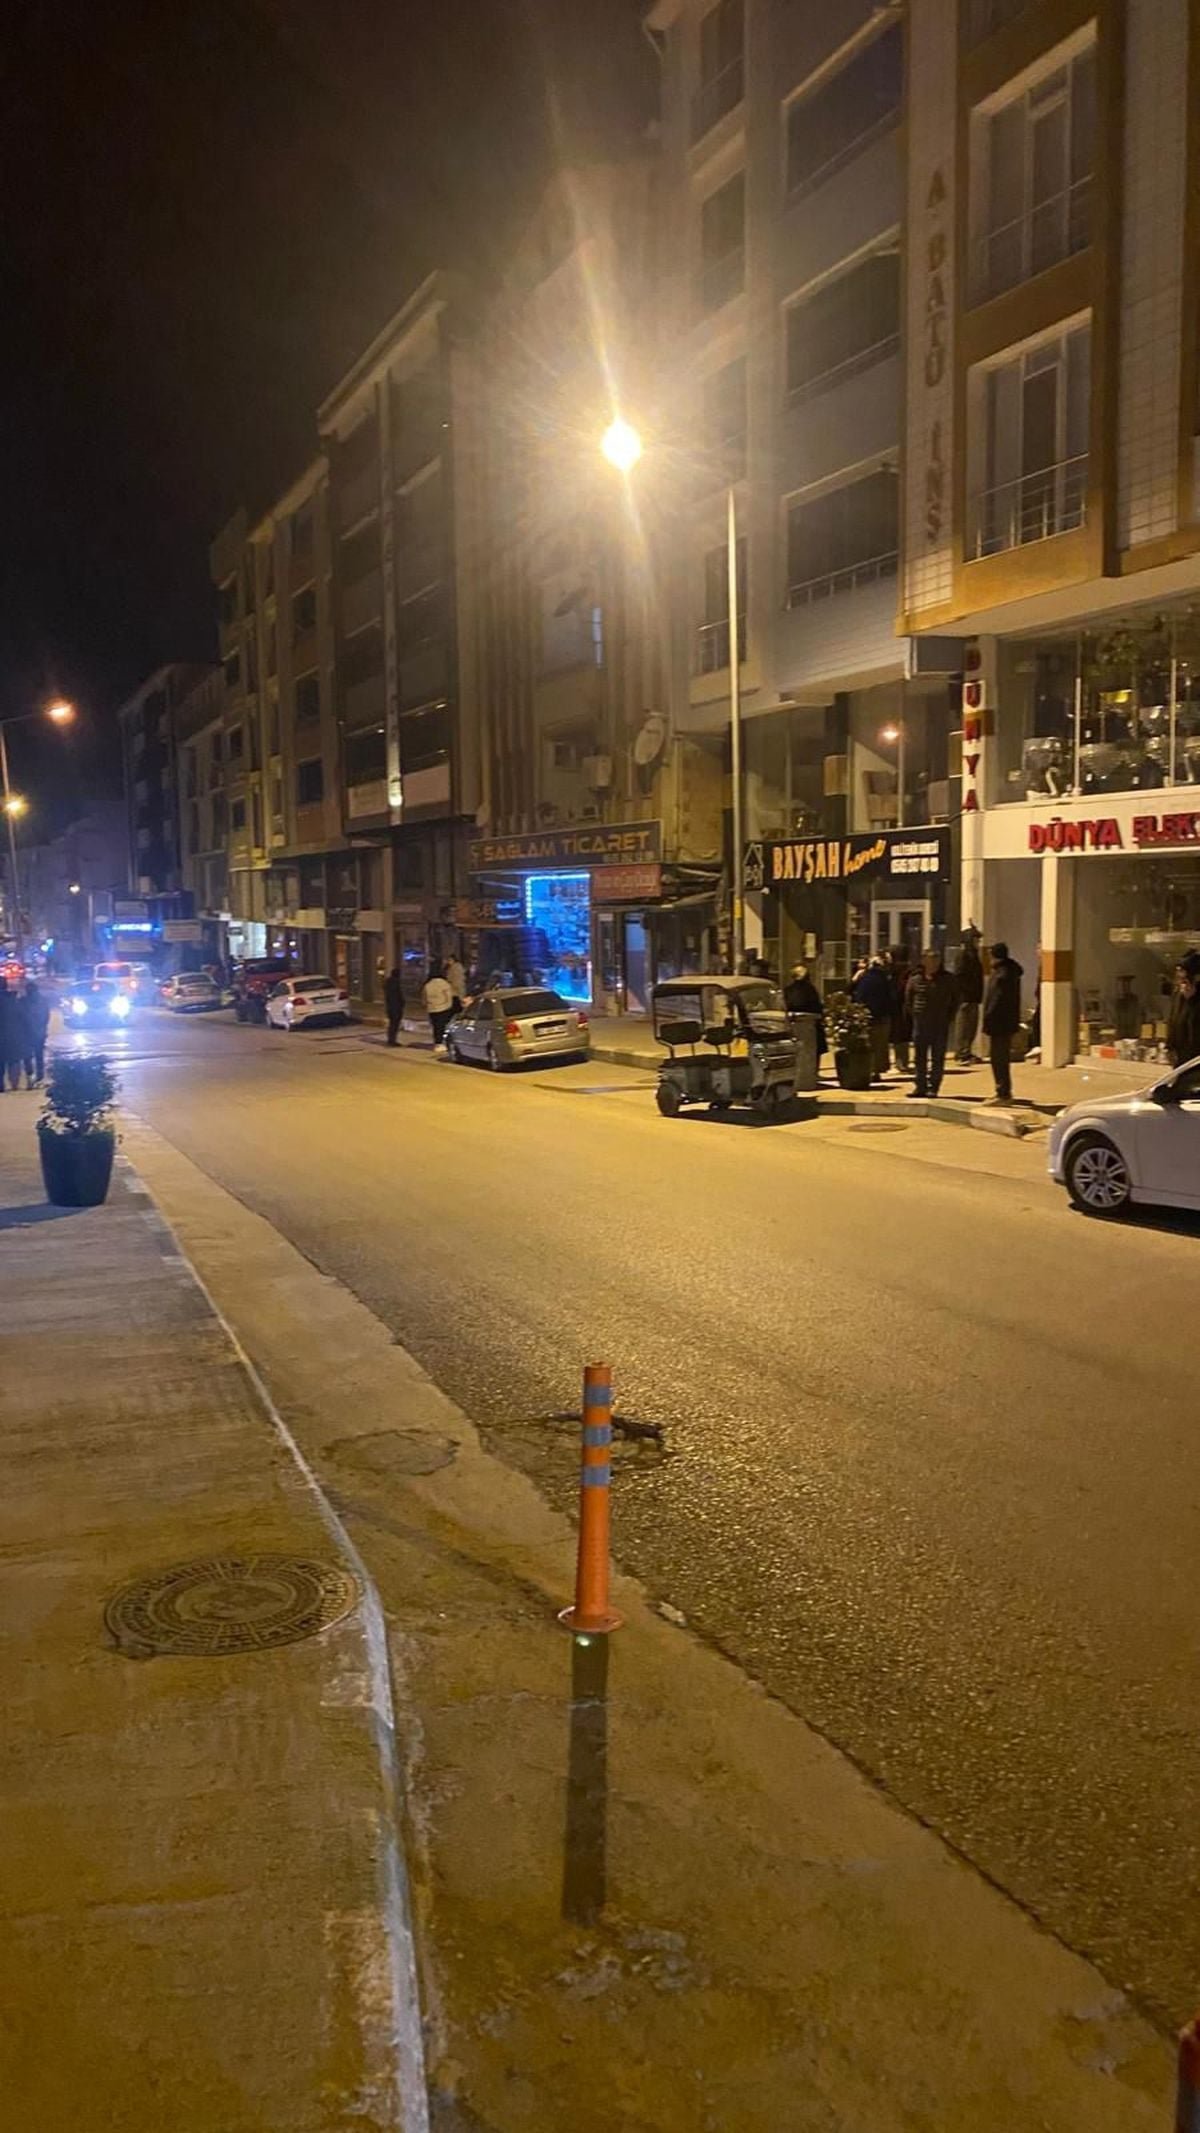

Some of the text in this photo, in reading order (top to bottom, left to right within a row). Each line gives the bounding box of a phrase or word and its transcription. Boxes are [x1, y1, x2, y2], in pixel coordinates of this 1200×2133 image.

[962, 647, 982, 812] DÜNYA
[562, 831, 649, 855] TİCARET
[1029, 817, 1123, 853] DÜNYA
[772, 842, 840, 883] BAYŞAH
